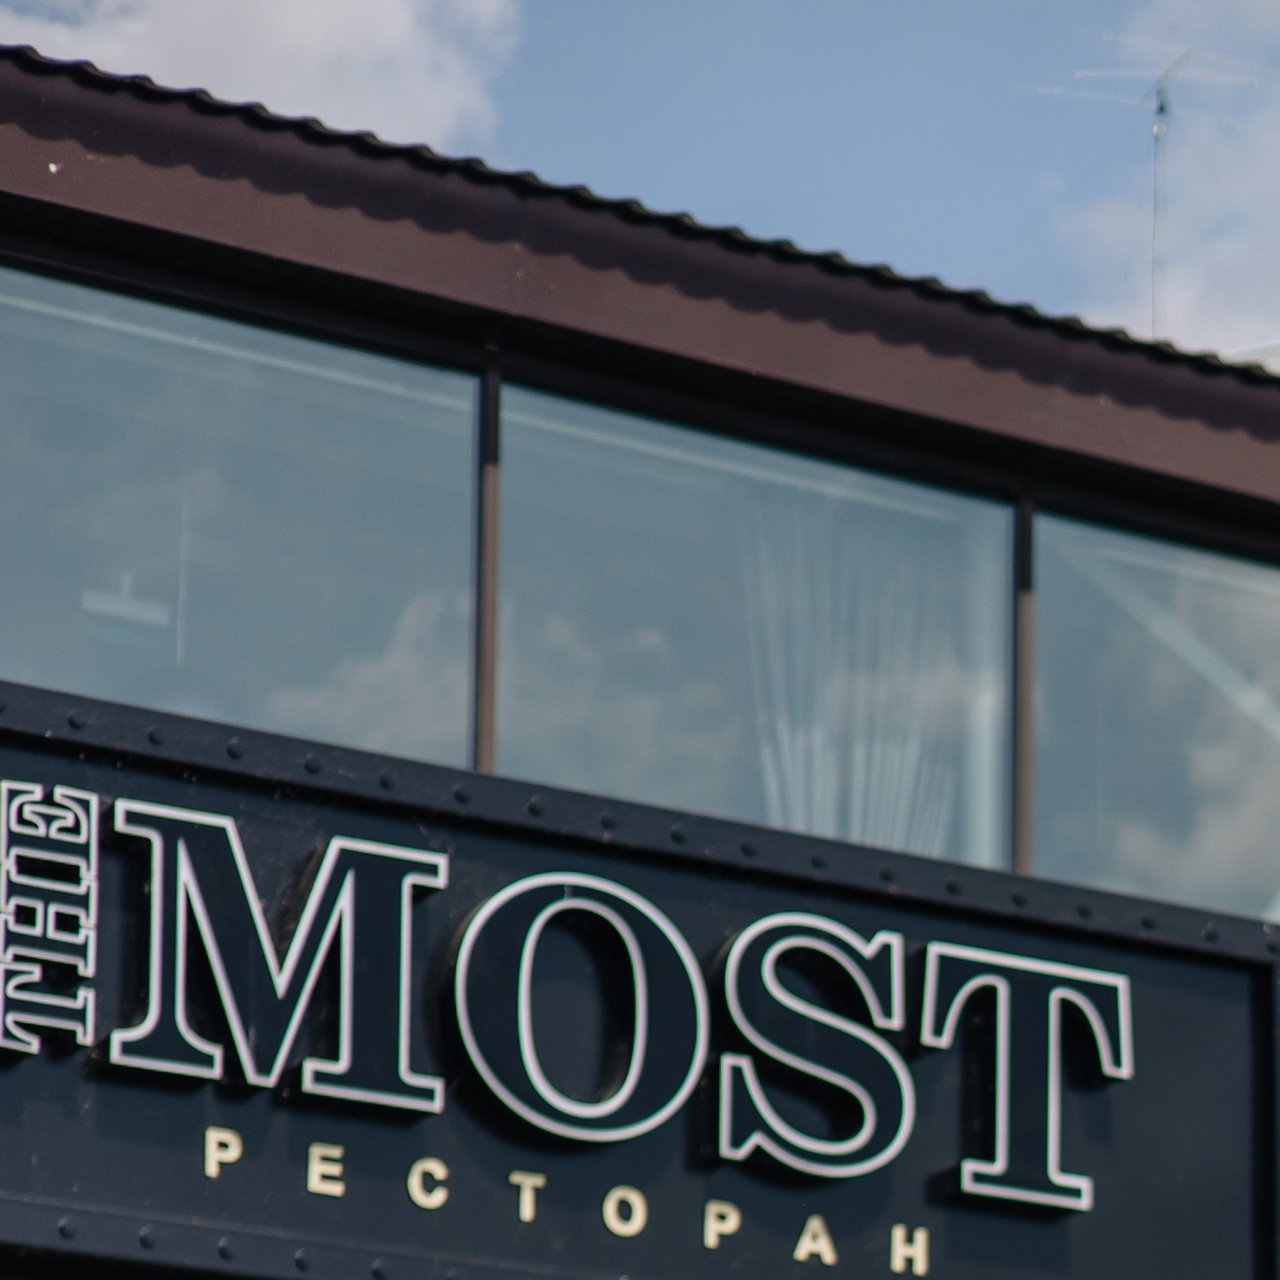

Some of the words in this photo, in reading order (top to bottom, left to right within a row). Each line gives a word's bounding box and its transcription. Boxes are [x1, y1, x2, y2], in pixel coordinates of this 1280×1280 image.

[0, 779, 99, 1055] THE
[110, 797, 1134, 1210] MOST
[204, 1126, 931, 1277] РЕСТОРАН
